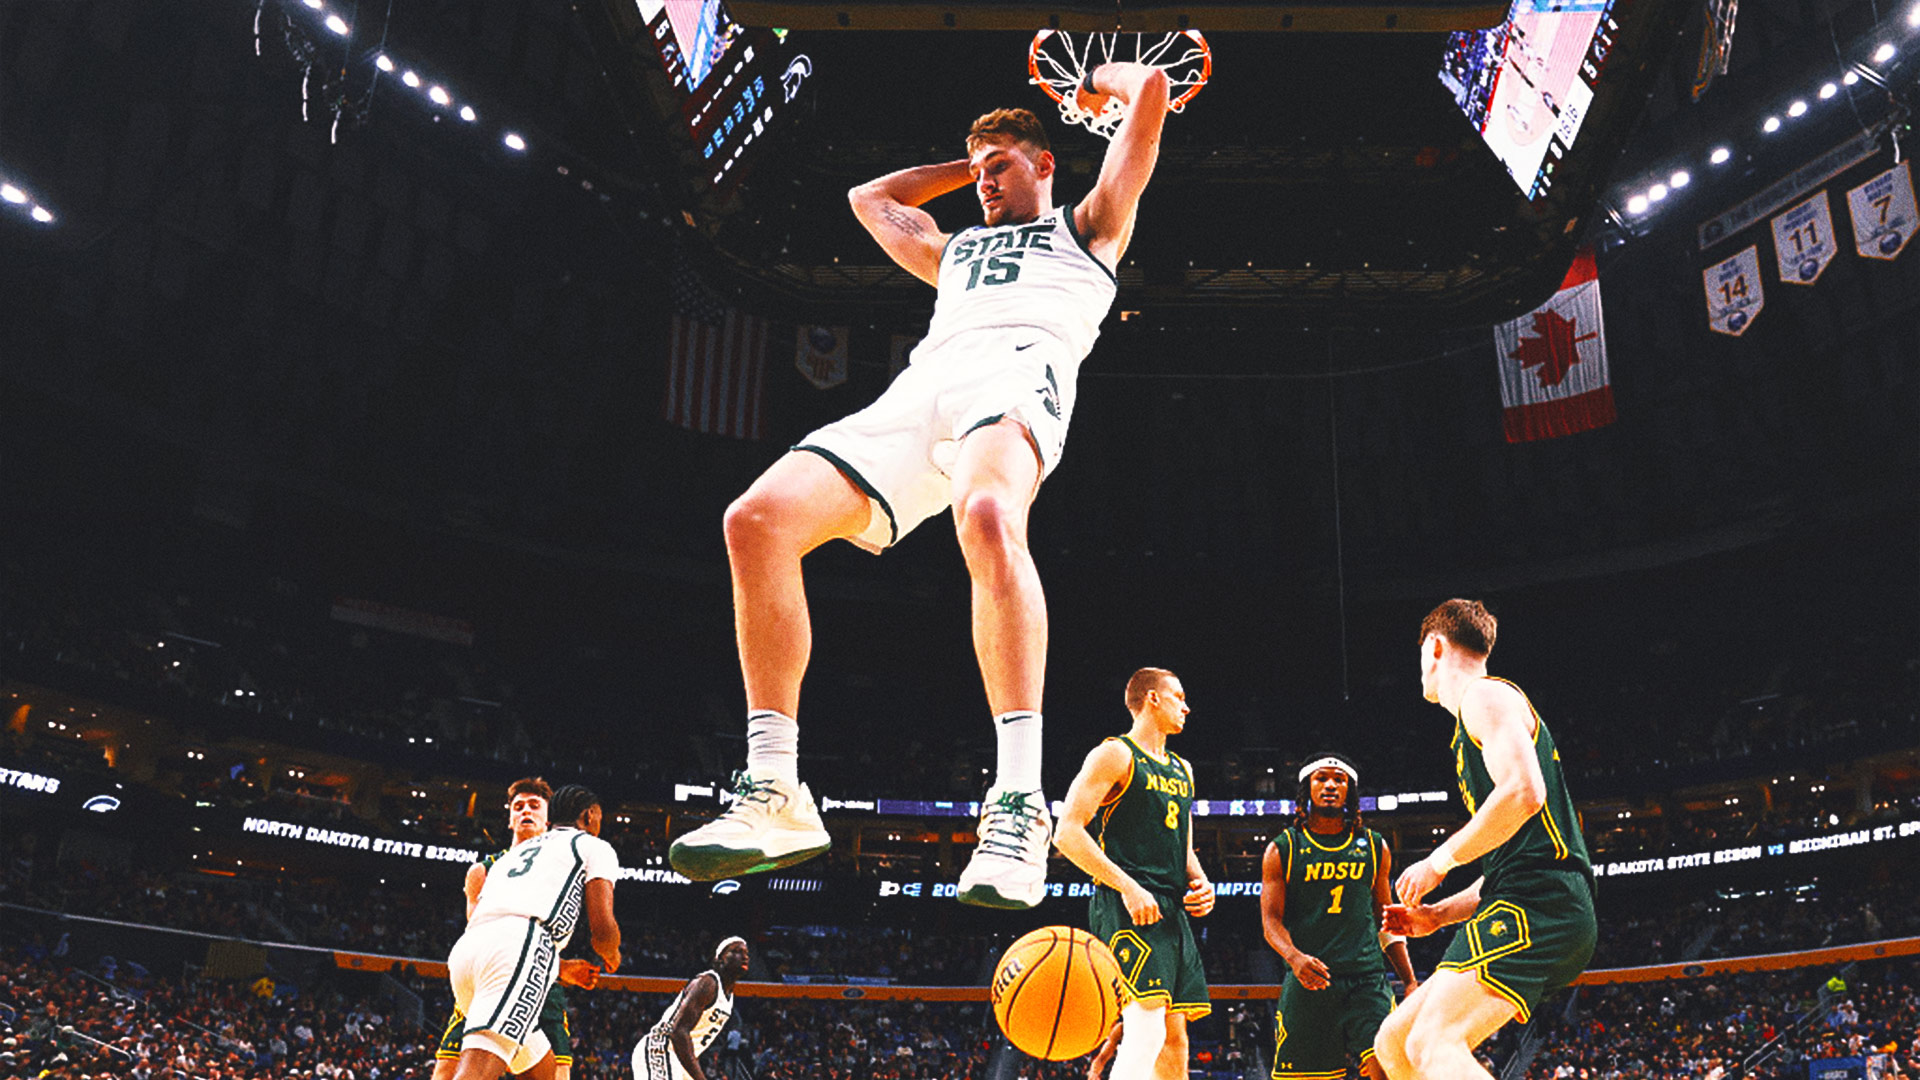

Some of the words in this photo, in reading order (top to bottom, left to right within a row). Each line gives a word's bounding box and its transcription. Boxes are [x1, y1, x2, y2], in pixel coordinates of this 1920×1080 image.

[1873, 194, 1894, 225] 7
[954, 225, 1056, 265] STATE
[1788, 220, 1818, 253] 11
[966, 251, 1024, 291] 15
[1718, 273, 1748, 305] 14
[1145, 773, 1189, 798] NDSU
[1165, 801, 1181, 830] 8
[243, 817, 303, 839] NORTH
[305, 826, 370, 850] DAKOTA
[372, 838, 423, 857] STATE
[425, 845, 479, 863] BISON
[1607, 858, 1664, 876] DAKOTA
[1667, 852, 1710, 870] STATE
[1713, 845, 1762, 863] BISON
[1788, 830, 1870, 853] MICHIGAN
[507, 846, 542, 878] 3
[1304, 862, 1366, 882] NDSU
[931, 882, 959, 898] 20
[1068, 882, 1096, 897] BA
[1327, 885, 1345, 914] 1
